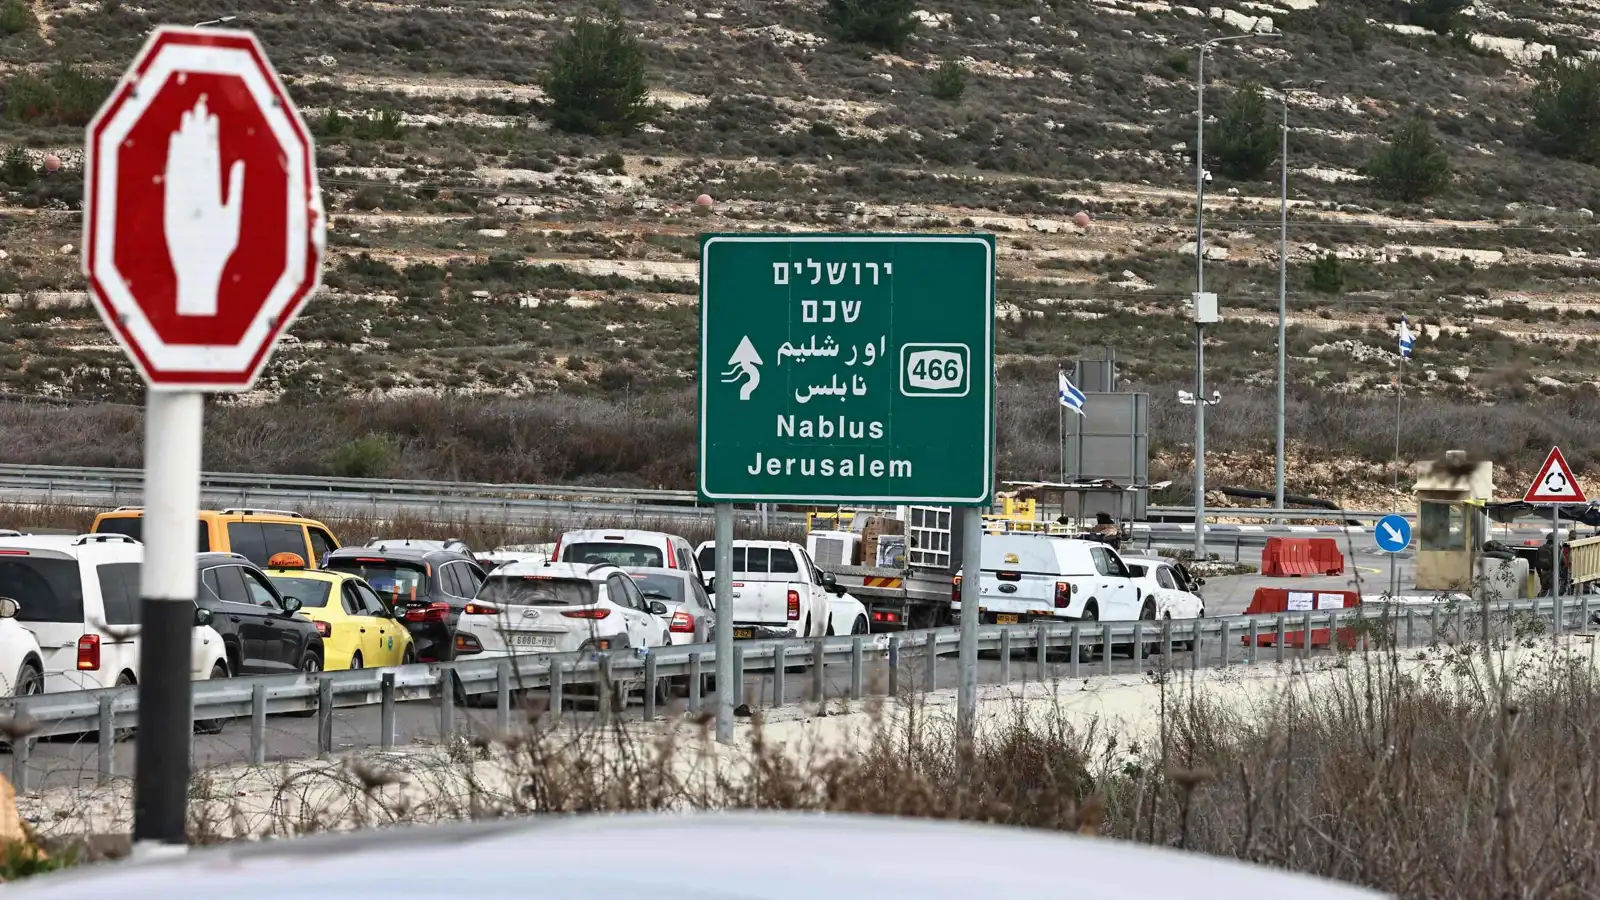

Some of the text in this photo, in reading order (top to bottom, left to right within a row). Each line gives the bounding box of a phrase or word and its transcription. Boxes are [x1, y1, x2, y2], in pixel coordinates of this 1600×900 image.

[773, 258, 892, 285] ירושלים
[801, 300, 862, 322] שכם
[912, 358, 959, 381] 466
[795, 374, 867, 403] نابلس
[777, 414, 884, 438] Nablus
[747, 452, 912, 478] Jerusalem
